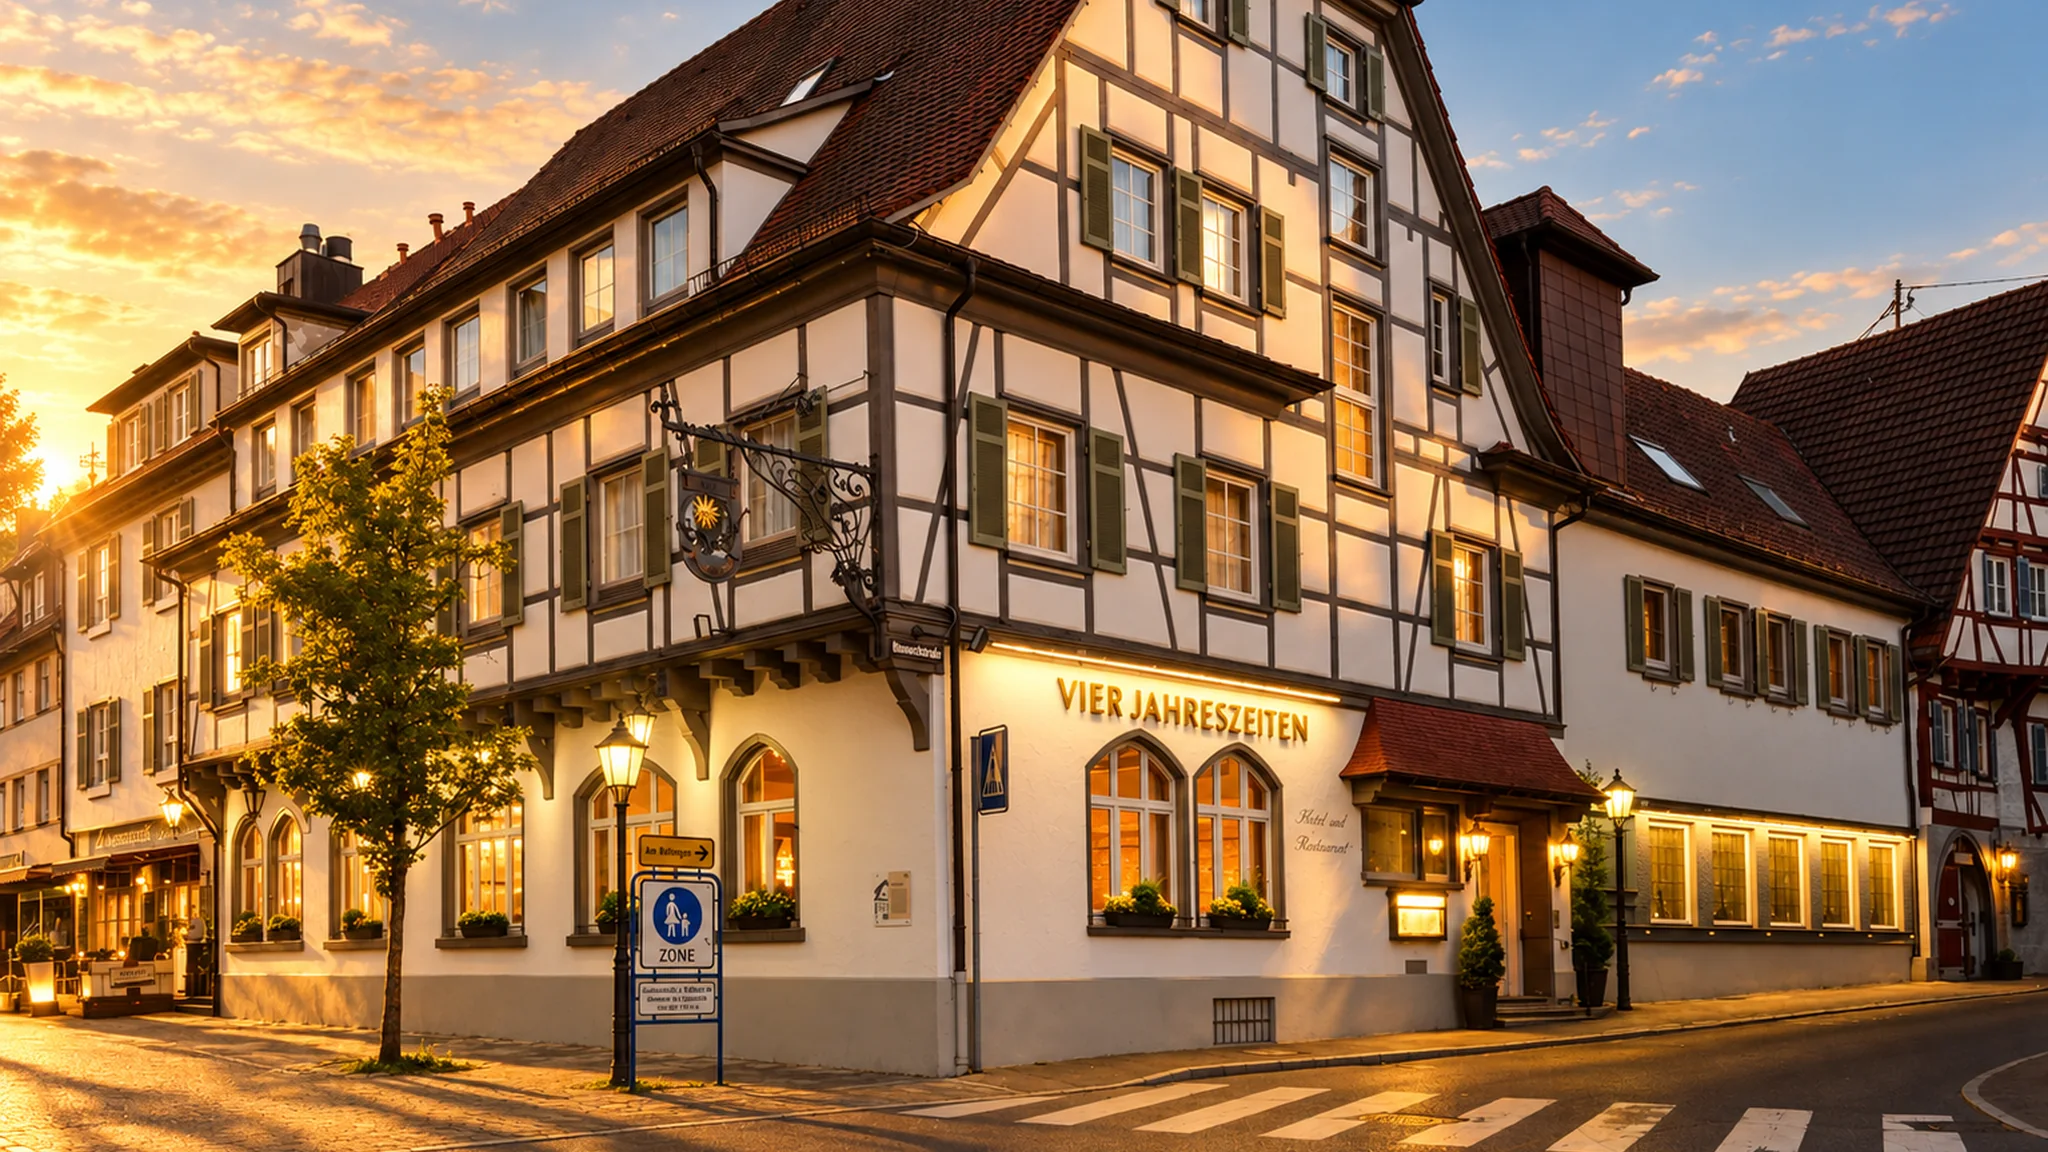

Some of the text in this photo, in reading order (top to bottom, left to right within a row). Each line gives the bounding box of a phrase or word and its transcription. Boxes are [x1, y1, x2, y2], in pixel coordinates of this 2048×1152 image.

[1057, 677, 1308, 742] VIER JAHRESZEITEN
[659, 949, 695, 963] ZONE
